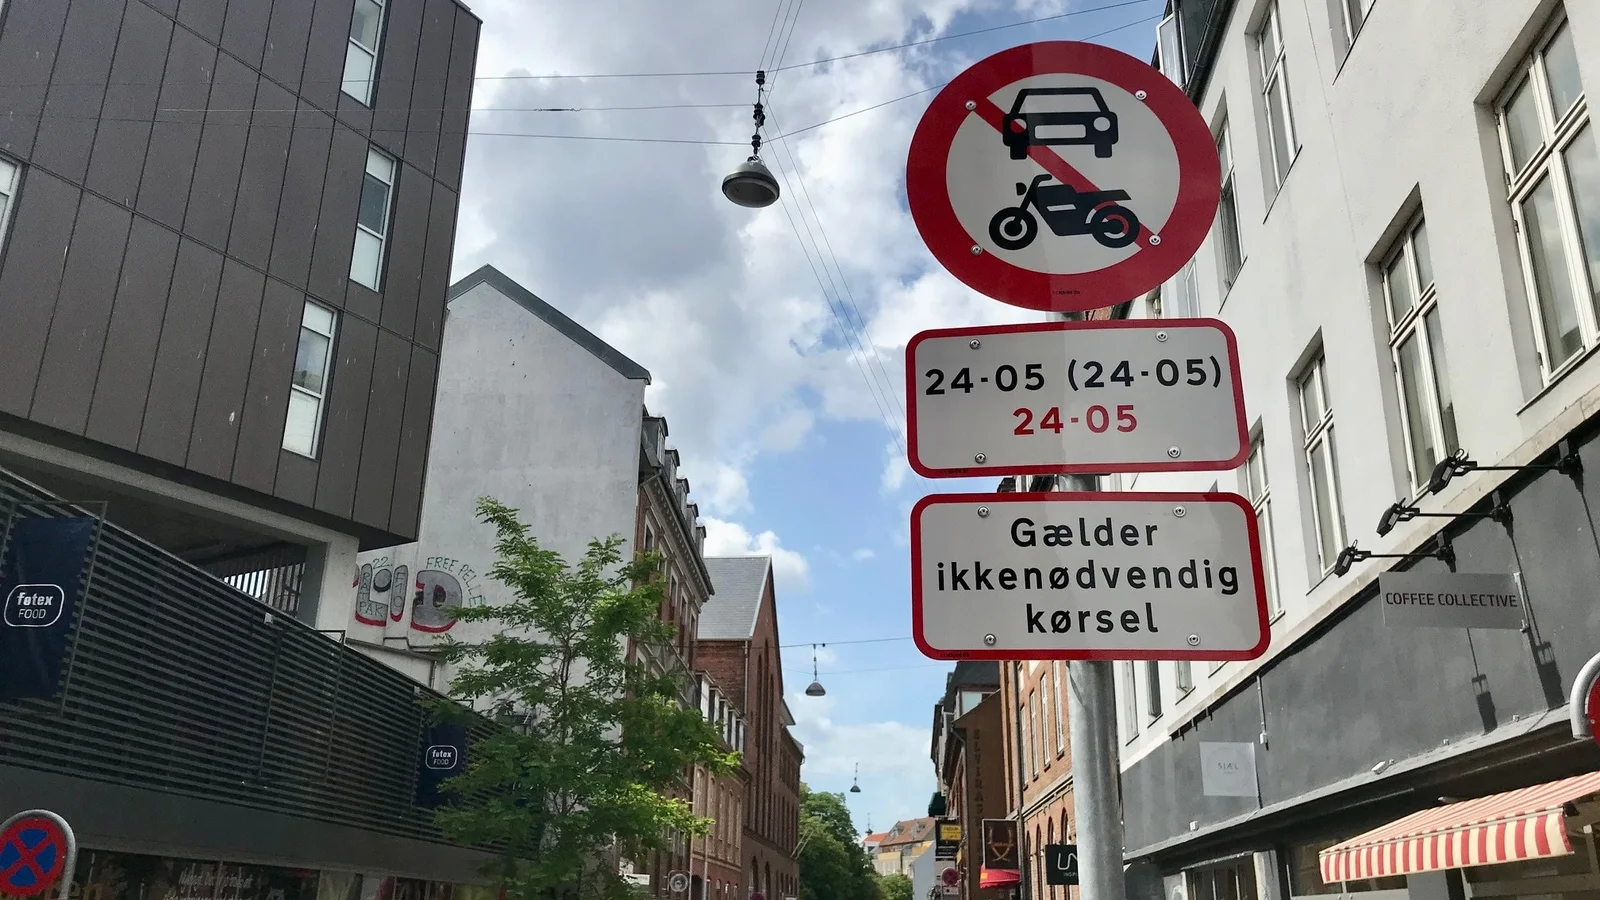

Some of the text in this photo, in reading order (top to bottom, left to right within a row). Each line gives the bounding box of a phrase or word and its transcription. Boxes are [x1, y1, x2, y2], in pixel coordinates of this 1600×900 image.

[925, 356, 1221, 395] 24-05 (24-05)
[1013, 405, 1137, 435] 24-05
[1010, 517, 1158, 547] Gælder
[426, 556, 459, 573] FREE
[937, 559, 1239, 595] ikkenødvendig
[17, 592, 54, 606] føtex
[18, 608, 47, 619] FOOD
[1385, 592, 1518, 608] COFFEE COLLECTIVE
[1026, 602, 1158, 634] kørsel
